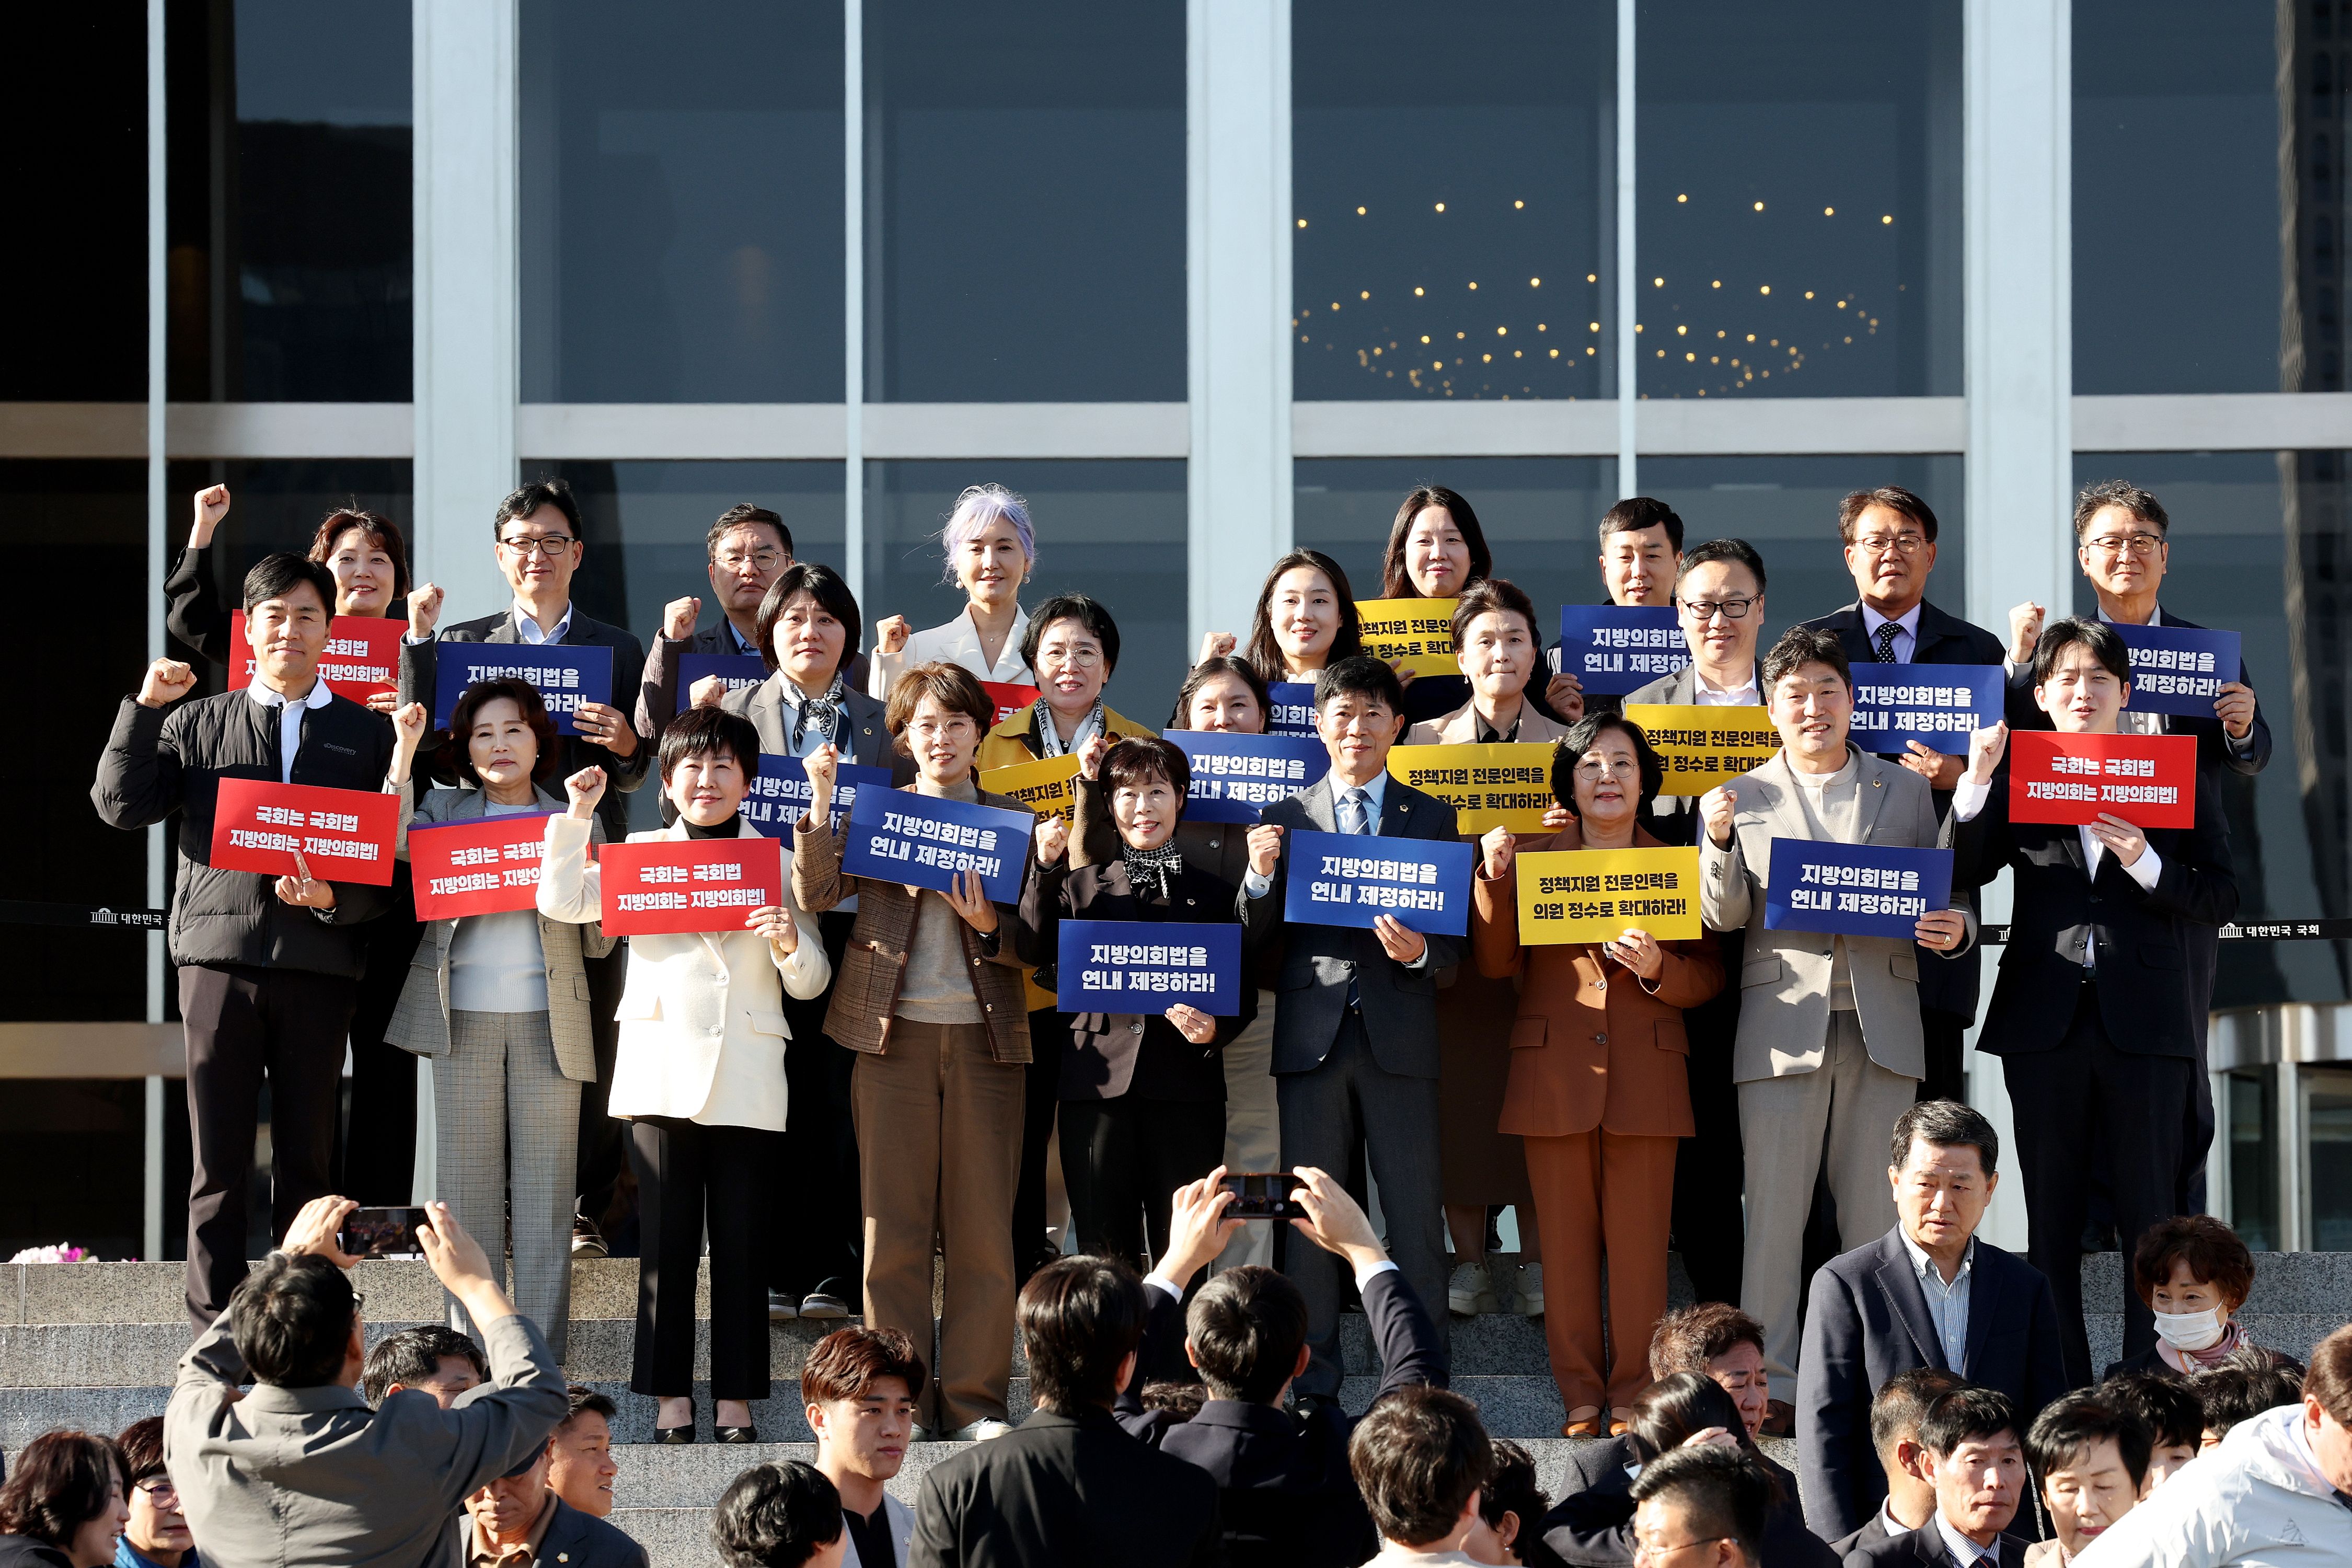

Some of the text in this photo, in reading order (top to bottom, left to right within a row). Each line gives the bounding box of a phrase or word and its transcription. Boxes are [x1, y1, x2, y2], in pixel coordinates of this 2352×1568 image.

[1592, 628, 1686, 648] 지방의회법
[1378, 642, 1423, 659] 정수로
[2127, 648, 2215, 672] 방의회법을
[1584, 653, 1693, 673] 연내 제정하
[2135, 673, 2221, 697] 제정하라!
[1857, 686, 1971, 707] 지방의회법을
[1849, 710, 1979, 731] 연내 제정하라!
[1646, 729, 1783, 747] 정책지원 전문인력을
[326, 743, 356, 755] Discovery
[1191, 754, 1305, 779] 지방의회법을
[1674, 755, 1719, 772] 정수로
[2051, 756, 2154, 777] 국회는 국회법
[1409, 767, 1544, 786] 정책지원 전문인력을
[749, 775, 856, 805] 지방의회을
[1187, 779, 1221, 799] 연내
[2027, 781, 2177, 803] 지방의회는 지방의회법!
[256, 806, 358, 832] 국회는 국회법
[737, 800, 771, 821] 연내
[881, 812, 997, 851] 지방의회법을
[229, 829, 378, 860] 지방의회는 지방의회법!
[450, 847, 499, 866] 국회는
[870, 836, 1000, 877] 연내 제정하라!
[639, 863, 741, 883] 국회는 국회법
[1320, 856, 1437, 884] 지방의회법을
[1801, 864, 1919, 891] 지방의회법을
[430, 872, 500, 895] 지방의회는
[1539, 872, 1678, 894] 정책지원 전문인력을
[617, 888, 765, 911] 지방의회는 지방의회법!
[1311, 881, 1444, 910] 연내 제정하라!
[1791, 889, 1926, 916] 연내 제정하라!
[121, 913, 162, 925] 대한민국
[1534, 898, 1686, 919] 의원 정수로 확대하라!
[2246, 925, 2319, 937] 대한민국 국회
[1090, 945, 1207, 966] 지방의회법을
[1082, 971, 1215, 993] 연내 제정하라!
